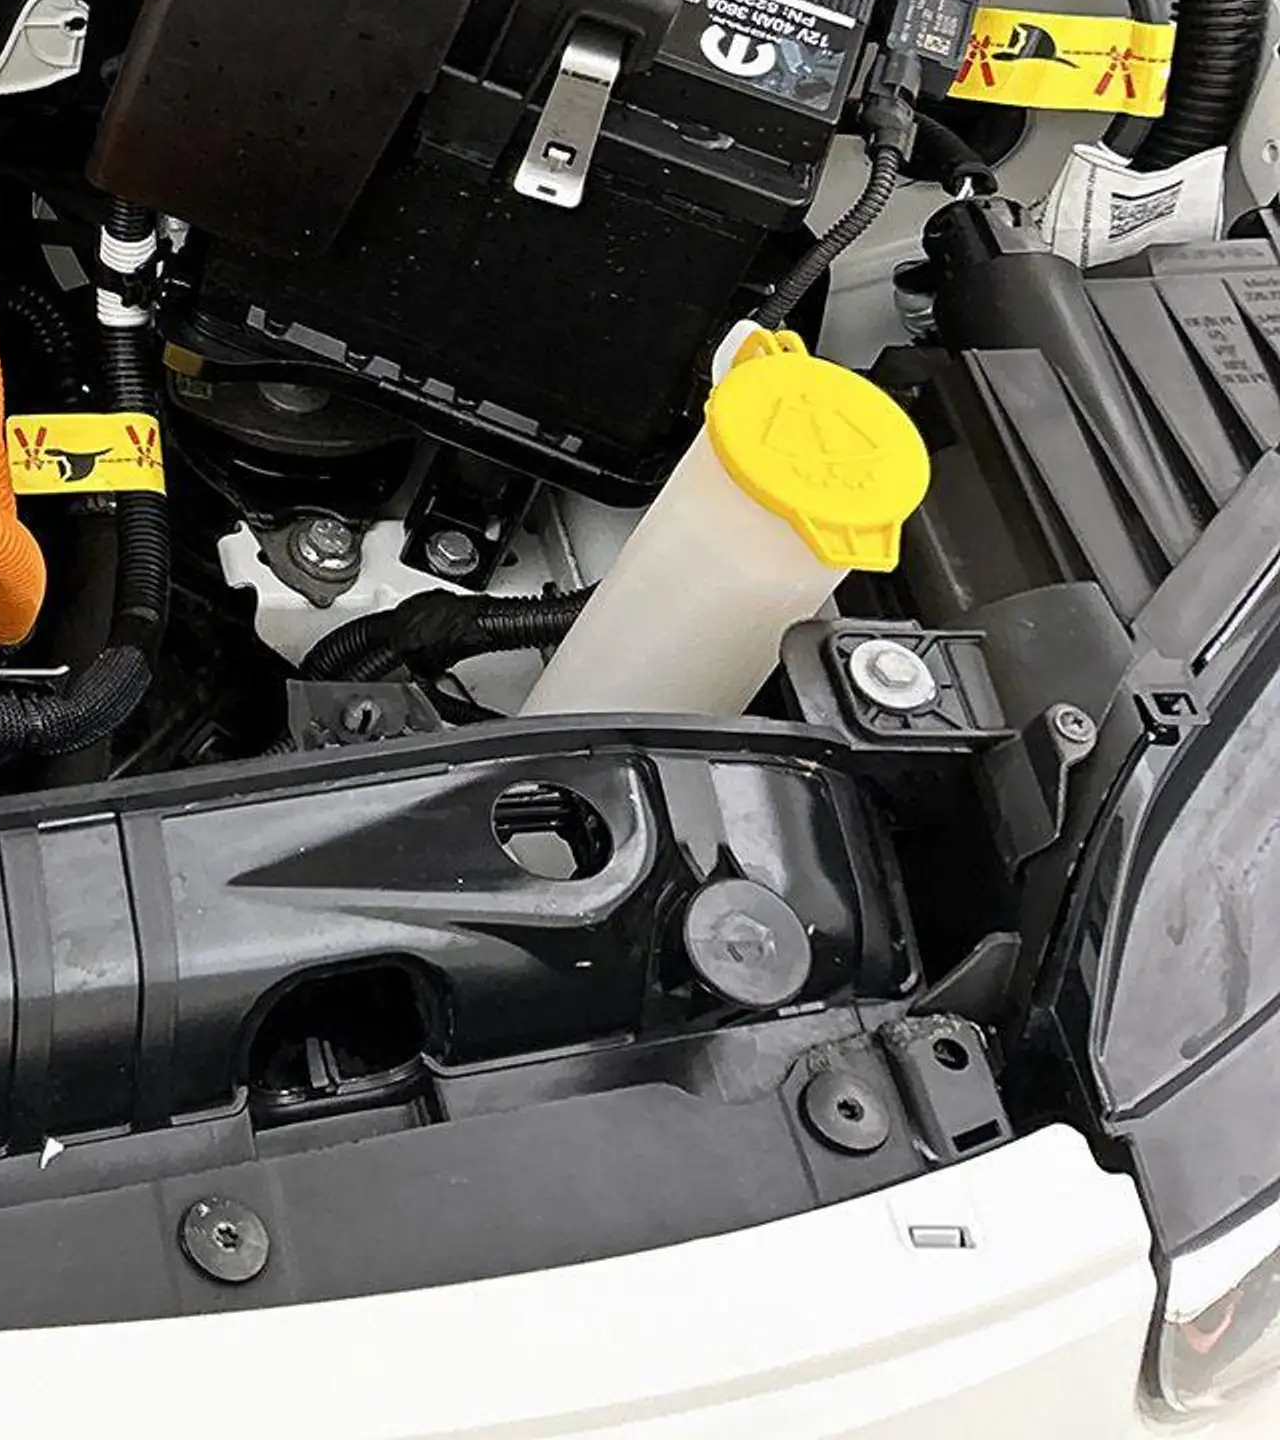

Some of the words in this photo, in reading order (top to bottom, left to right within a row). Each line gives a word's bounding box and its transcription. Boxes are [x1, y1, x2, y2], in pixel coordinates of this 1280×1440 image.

[751, 9, 795, 35] 40Ah
[781, 7, 816, 28] PN:
[795, 28, 830, 48] 12V
